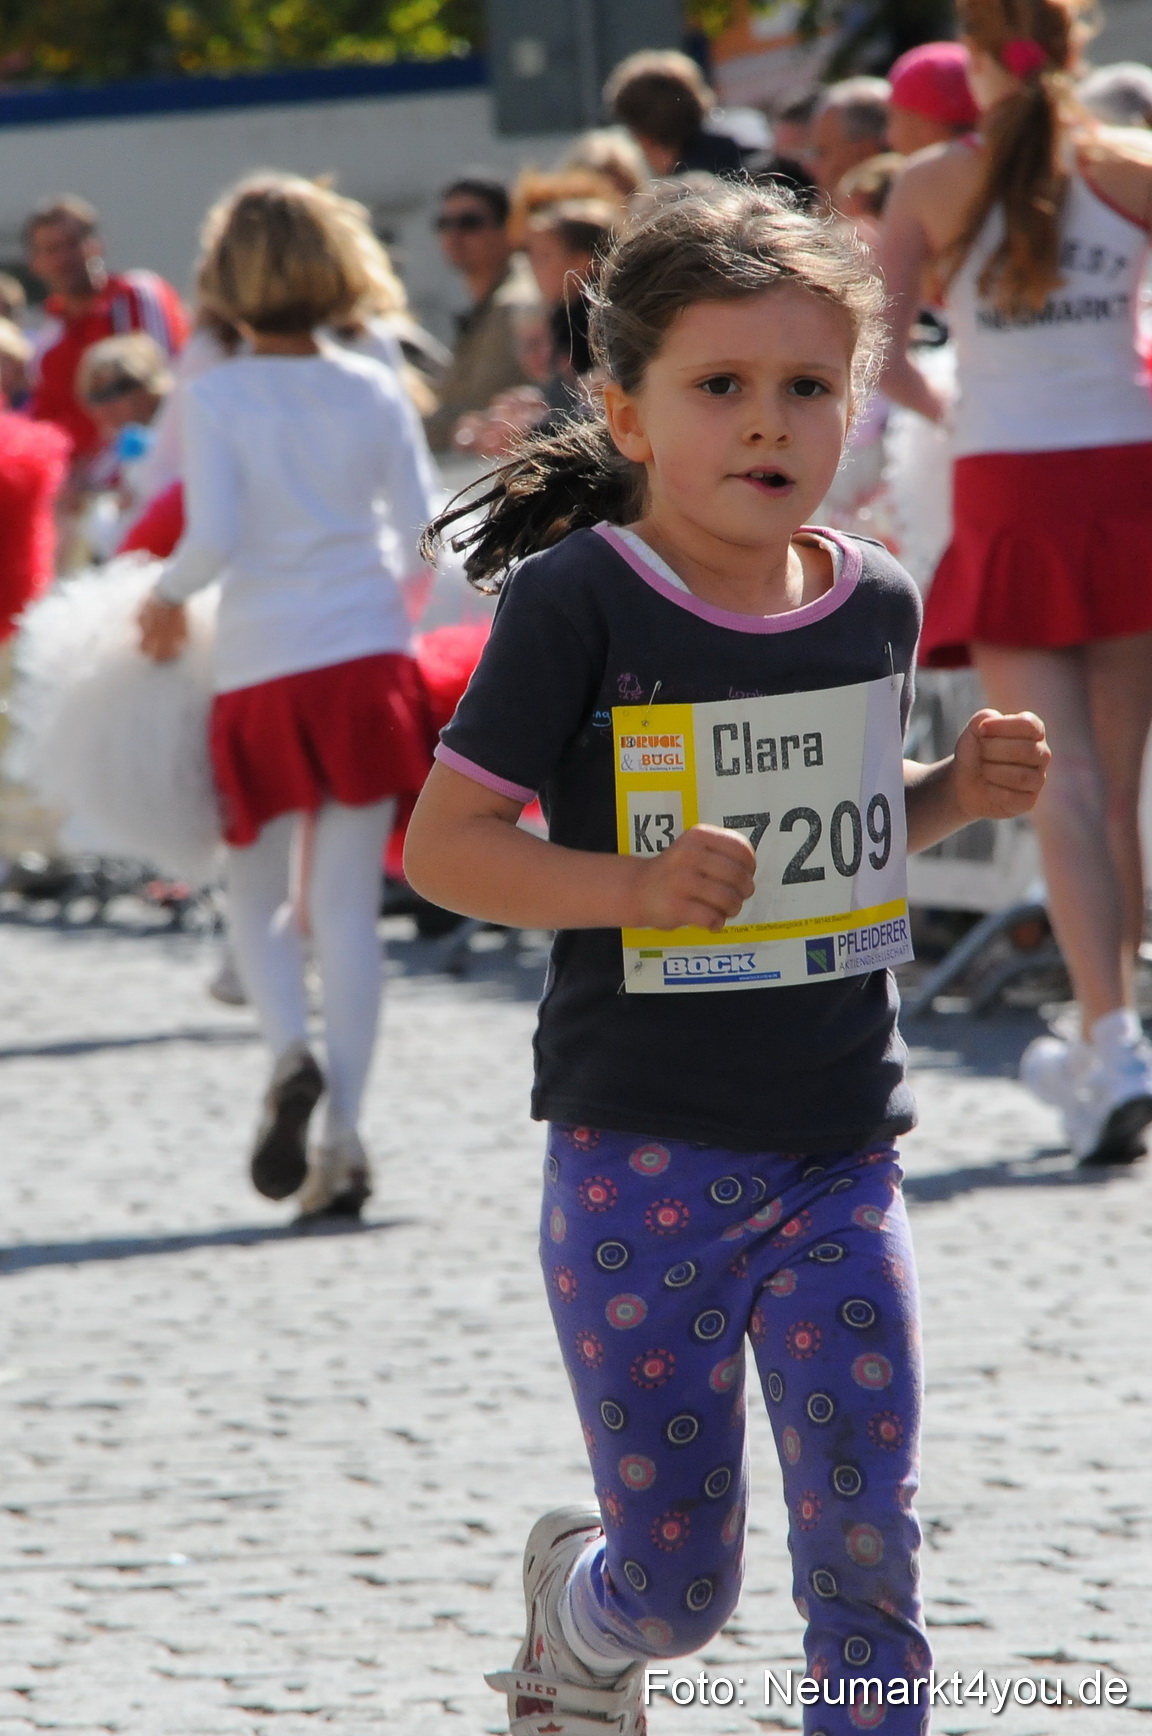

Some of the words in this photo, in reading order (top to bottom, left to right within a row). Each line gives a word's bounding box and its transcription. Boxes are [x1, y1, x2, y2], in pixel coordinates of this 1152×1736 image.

[712, 721, 824, 777] Clara
[633, 813, 675, 853] K3
[722, 793, 892, 885] 7209
[838, 919, 908, 957] PFLEIDERER
[839, 945, 910, 970] AKTIENGESELLSCHAFT
[663, 953, 755, 976] BOCK
